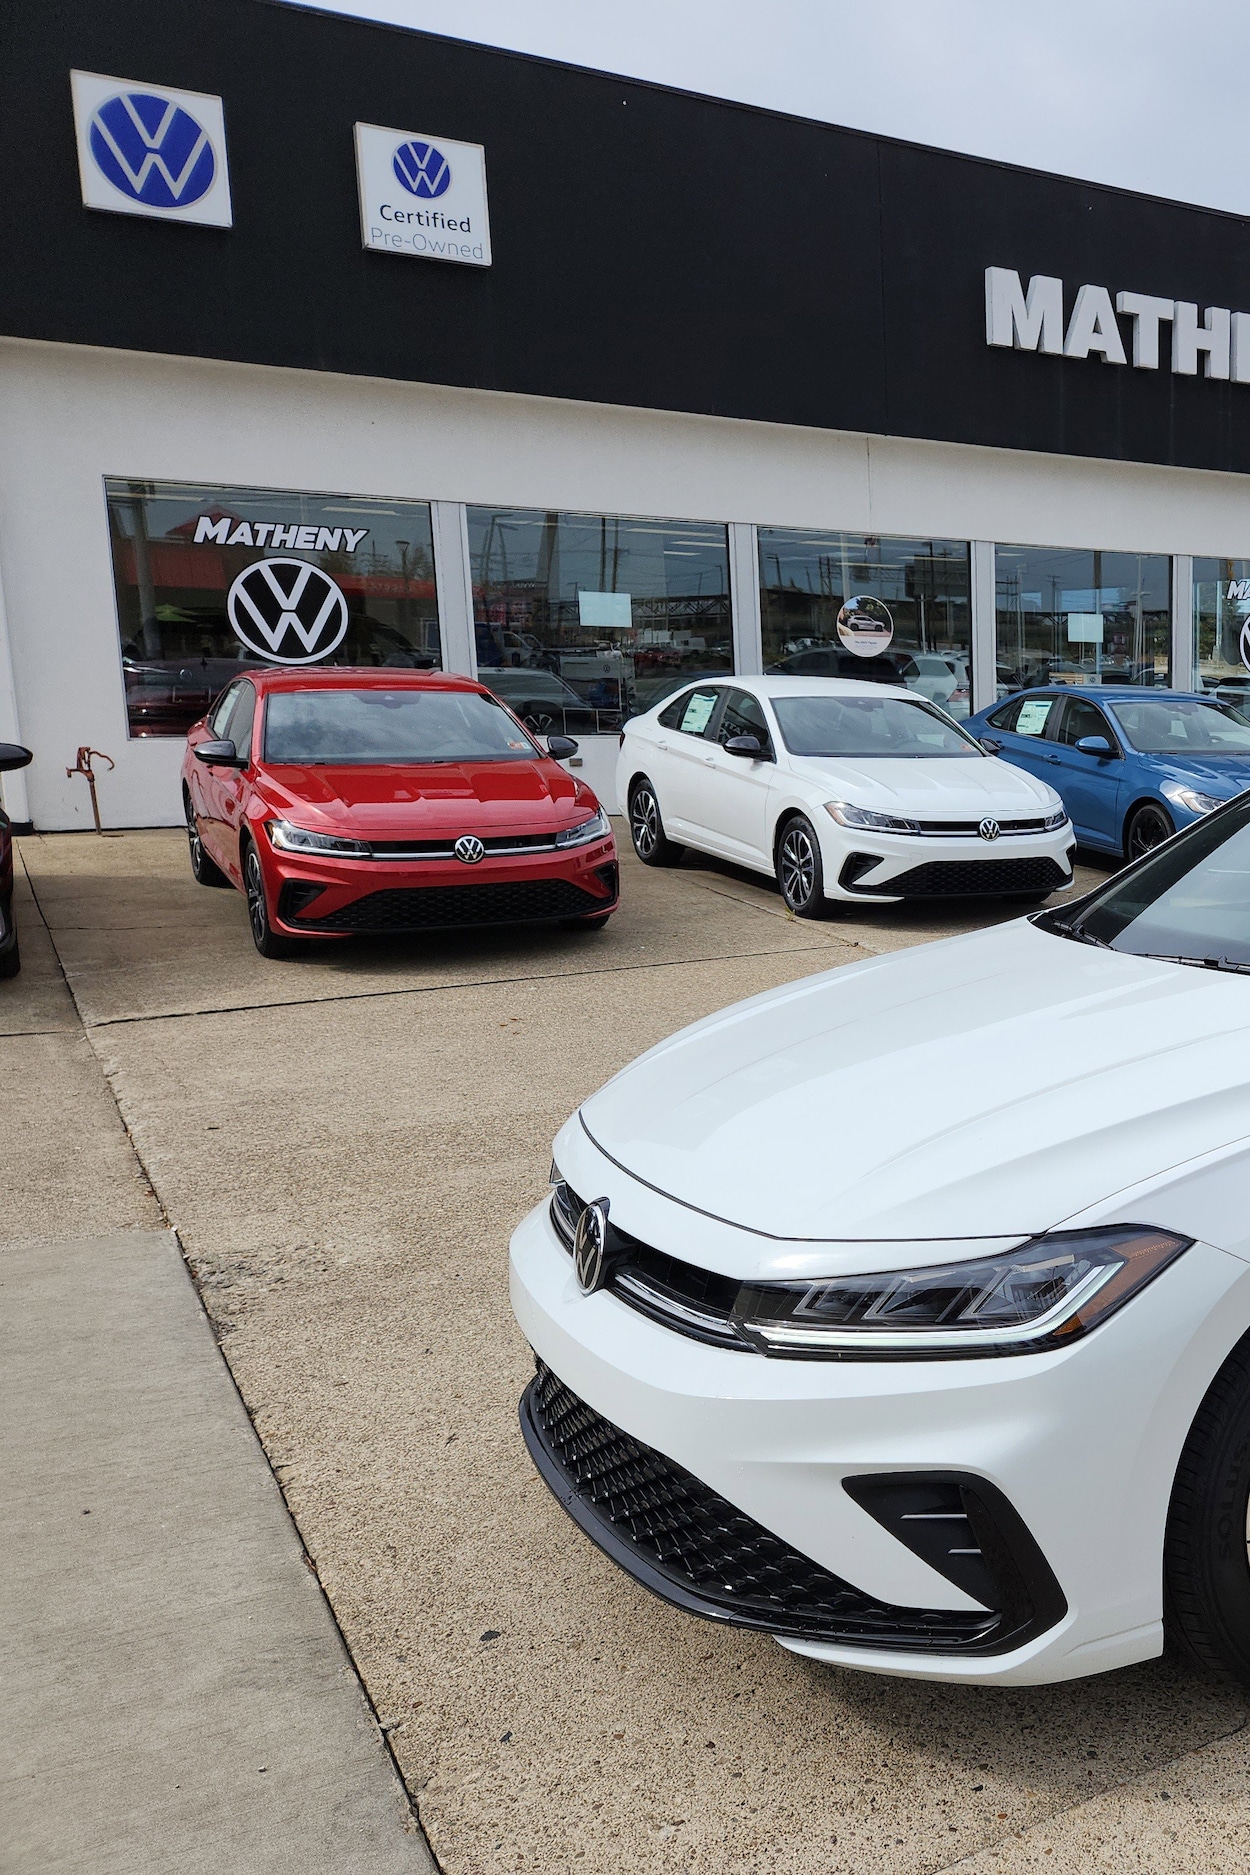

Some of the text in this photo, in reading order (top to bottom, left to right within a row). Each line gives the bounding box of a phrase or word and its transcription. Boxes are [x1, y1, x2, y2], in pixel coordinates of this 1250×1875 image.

[86, 90, 218, 211] VW
[391, 140, 453, 200] VW
[379, 204, 472, 233] Certified
[371, 227, 484, 260] Pre-Owned
[193, 515, 368, 552] MATHENY
[227, 556, 349, 665] VW
